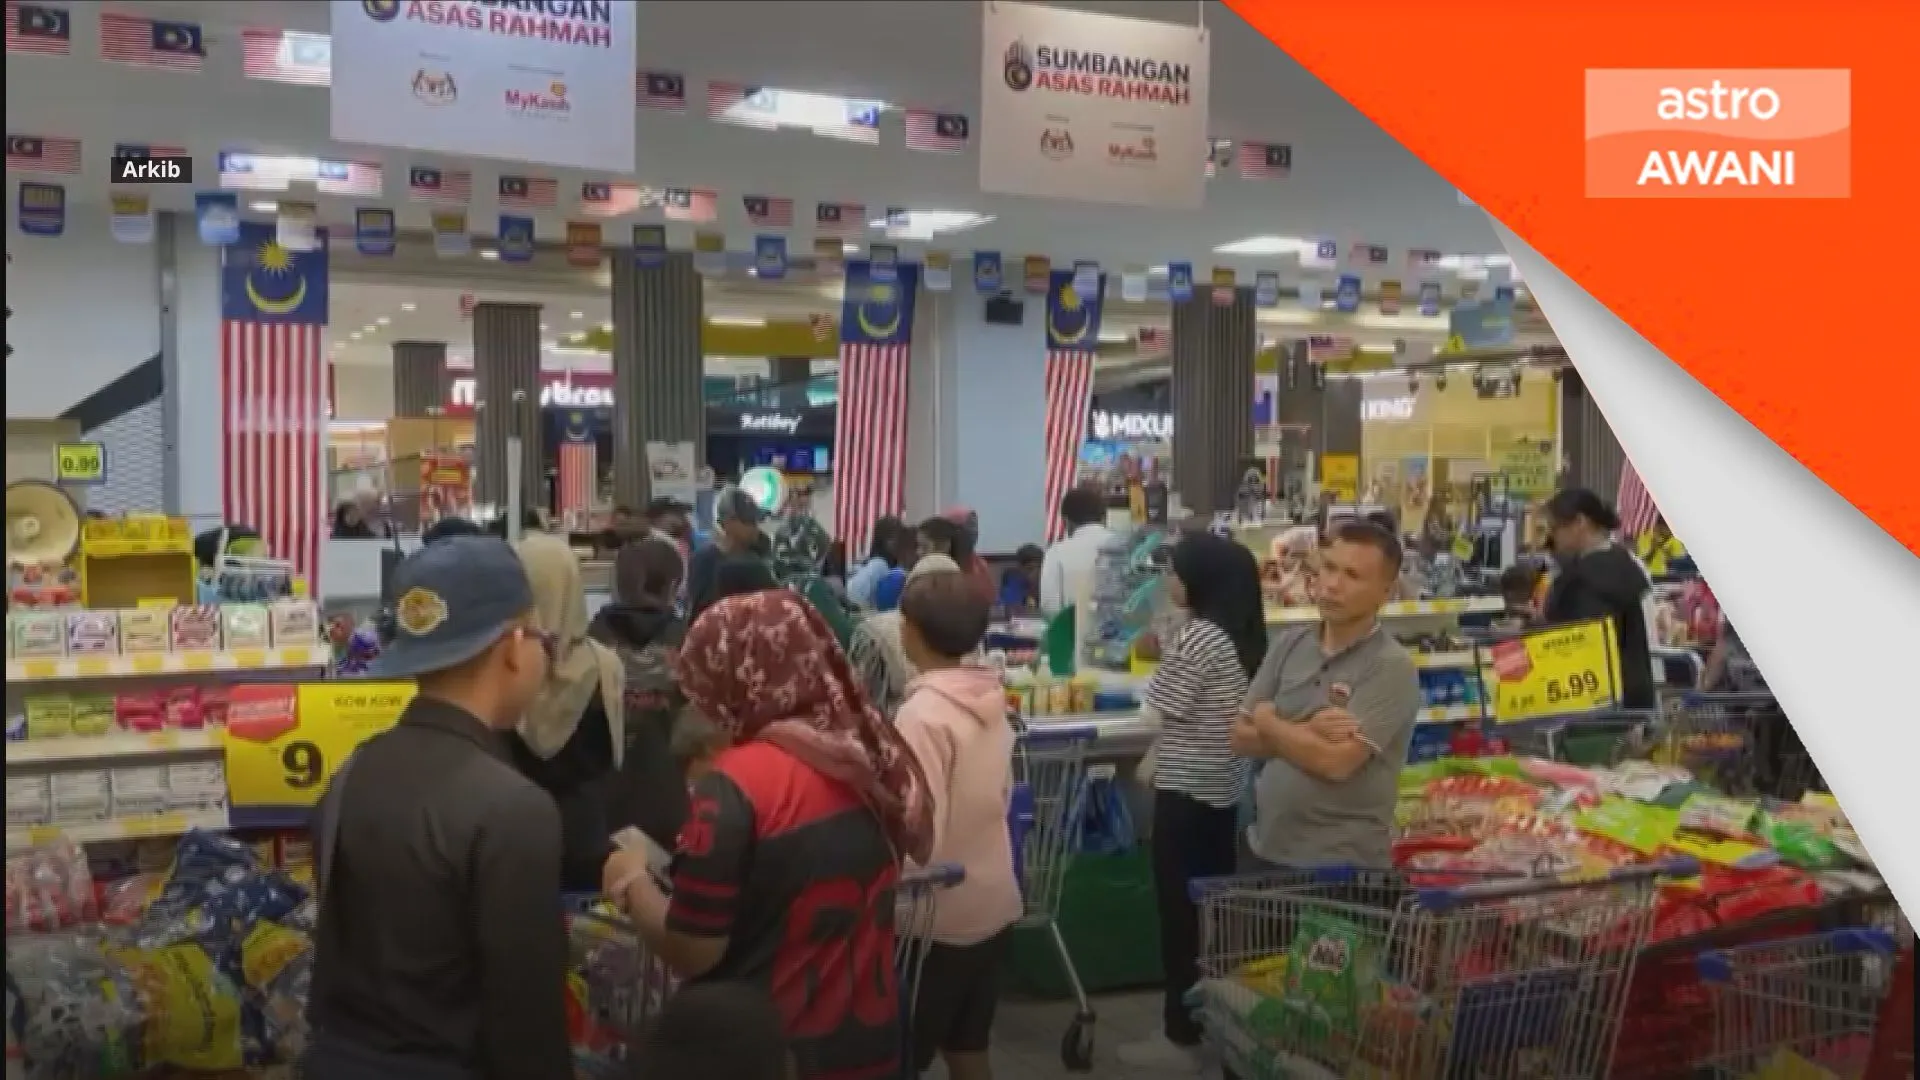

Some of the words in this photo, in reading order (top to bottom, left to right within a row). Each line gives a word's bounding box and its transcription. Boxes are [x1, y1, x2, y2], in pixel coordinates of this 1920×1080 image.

[407, 2, 482, 29] ASAS
[490, 10, 611, 47] RAHMAH
[1037, 46, 1189, 84] SUMBANGAN
[1036, 71, 1094, 95] ASAS
[1100, 78, 1189, 105] RAHMAH
[1547, 668, 1599, 703] 5.99
[283, 741, 323, 787] 9
